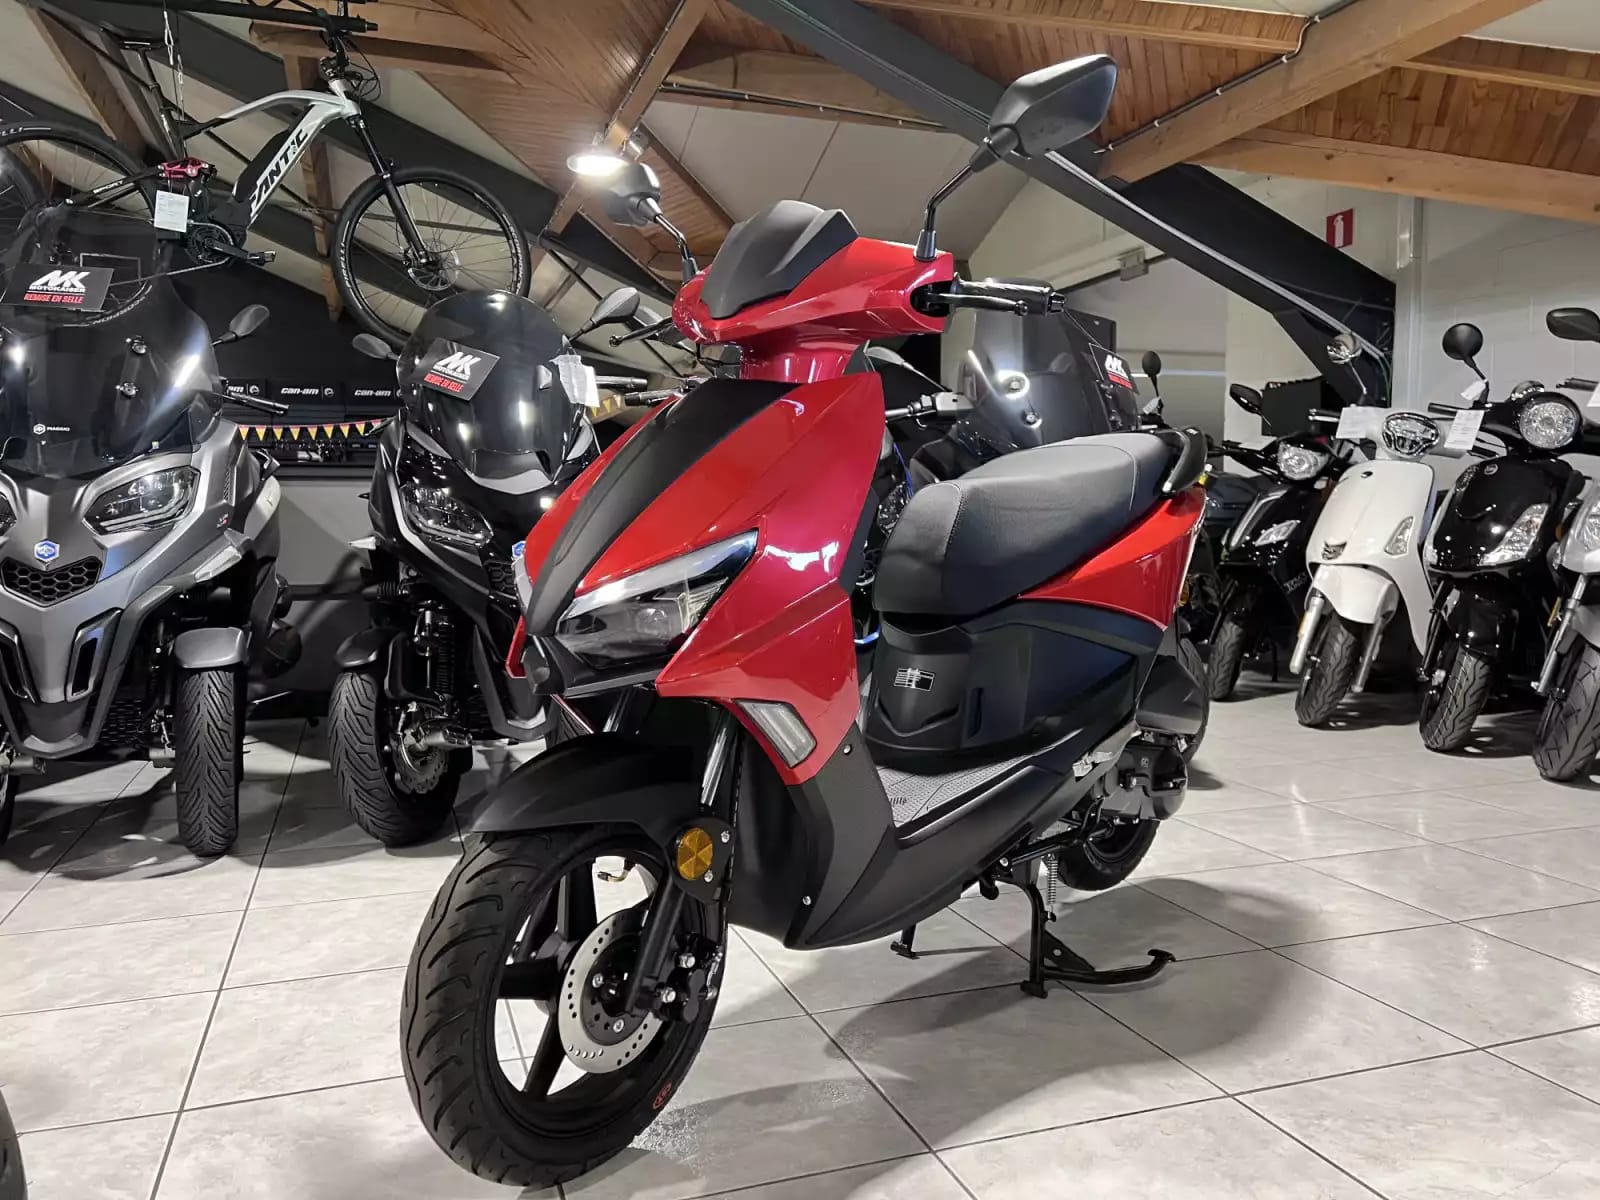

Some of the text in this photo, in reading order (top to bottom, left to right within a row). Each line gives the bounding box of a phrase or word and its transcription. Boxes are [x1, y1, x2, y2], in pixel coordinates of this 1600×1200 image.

[24, 293, 84, 304] REMISE EN SELLE
[281, 387, 319, 395] can-am
[354, 389, 391, 397] can-am
